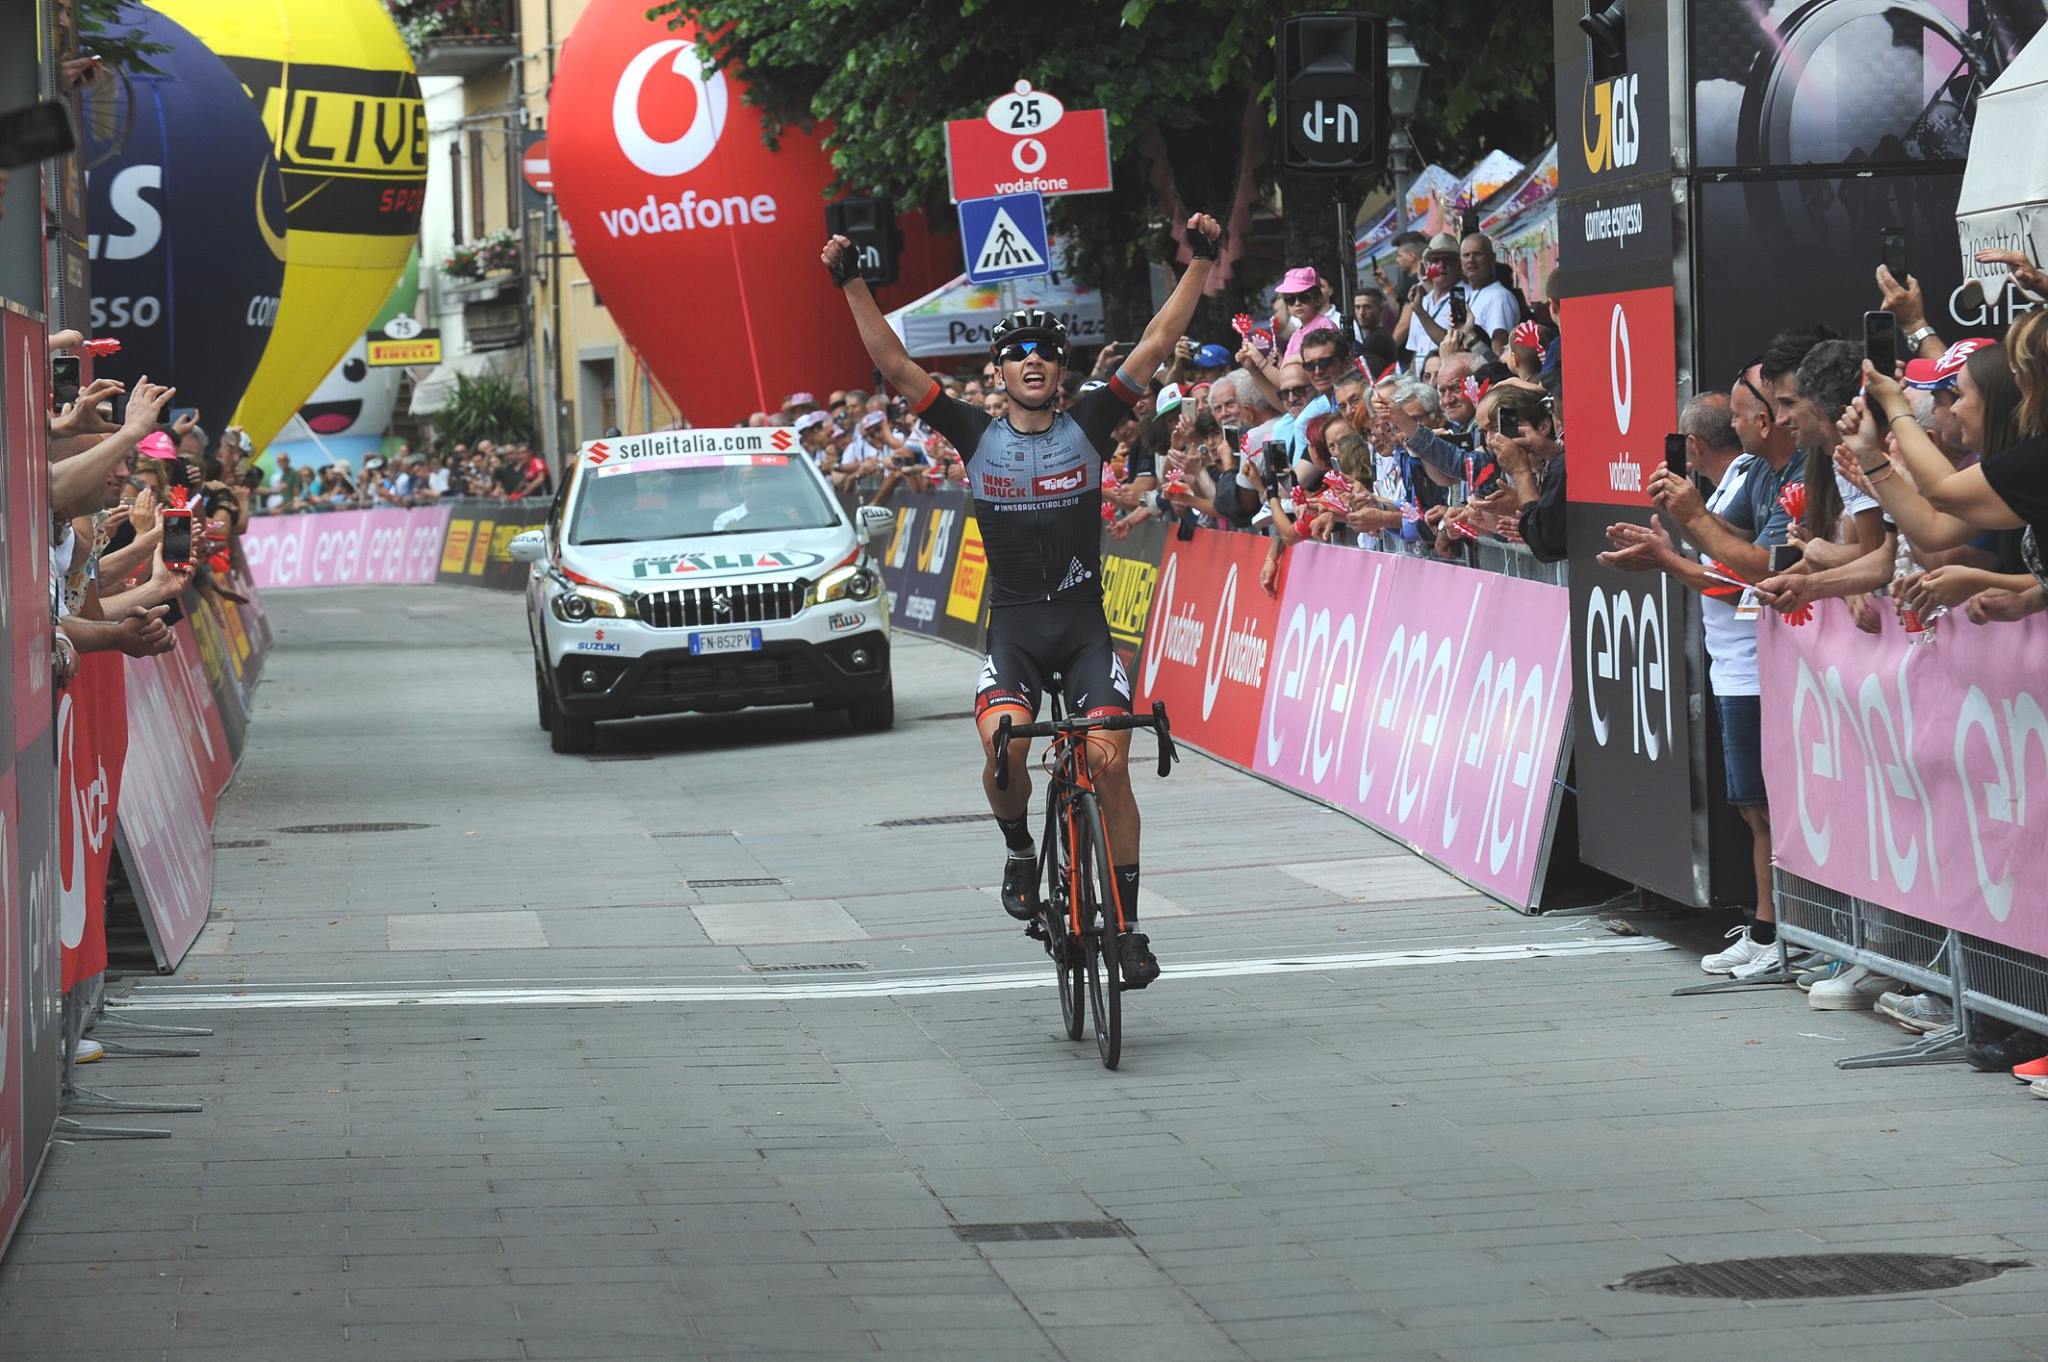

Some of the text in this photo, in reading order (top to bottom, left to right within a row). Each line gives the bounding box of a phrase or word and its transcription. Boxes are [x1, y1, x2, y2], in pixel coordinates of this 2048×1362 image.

[1010, 100, 1041, 128] 25
[1612, 73, 1639, 168] GLS
[994, 176, 1069, 194] vodafone
[600, 190, 777, 237] vodafone
[1611, 203, 1643, 249] espresso
[374, 345, 435, 360] PIRELLI
[619, 434, 762, 459] selleitalia.com
[1609, 451, 1641, 492] vodafone
[983, 487, 1026, 498] BRUCK
[633, 552, 795, 578] ITALIA
[577, 642, 620, 652] SUZUKI
[1225, 617, 1267, 688] vodafone
[1587, 571, 1673, 761] enel
[1267, 563, 1570, 877] enel enel enel
[1793, 644, 1941, 895] enel
